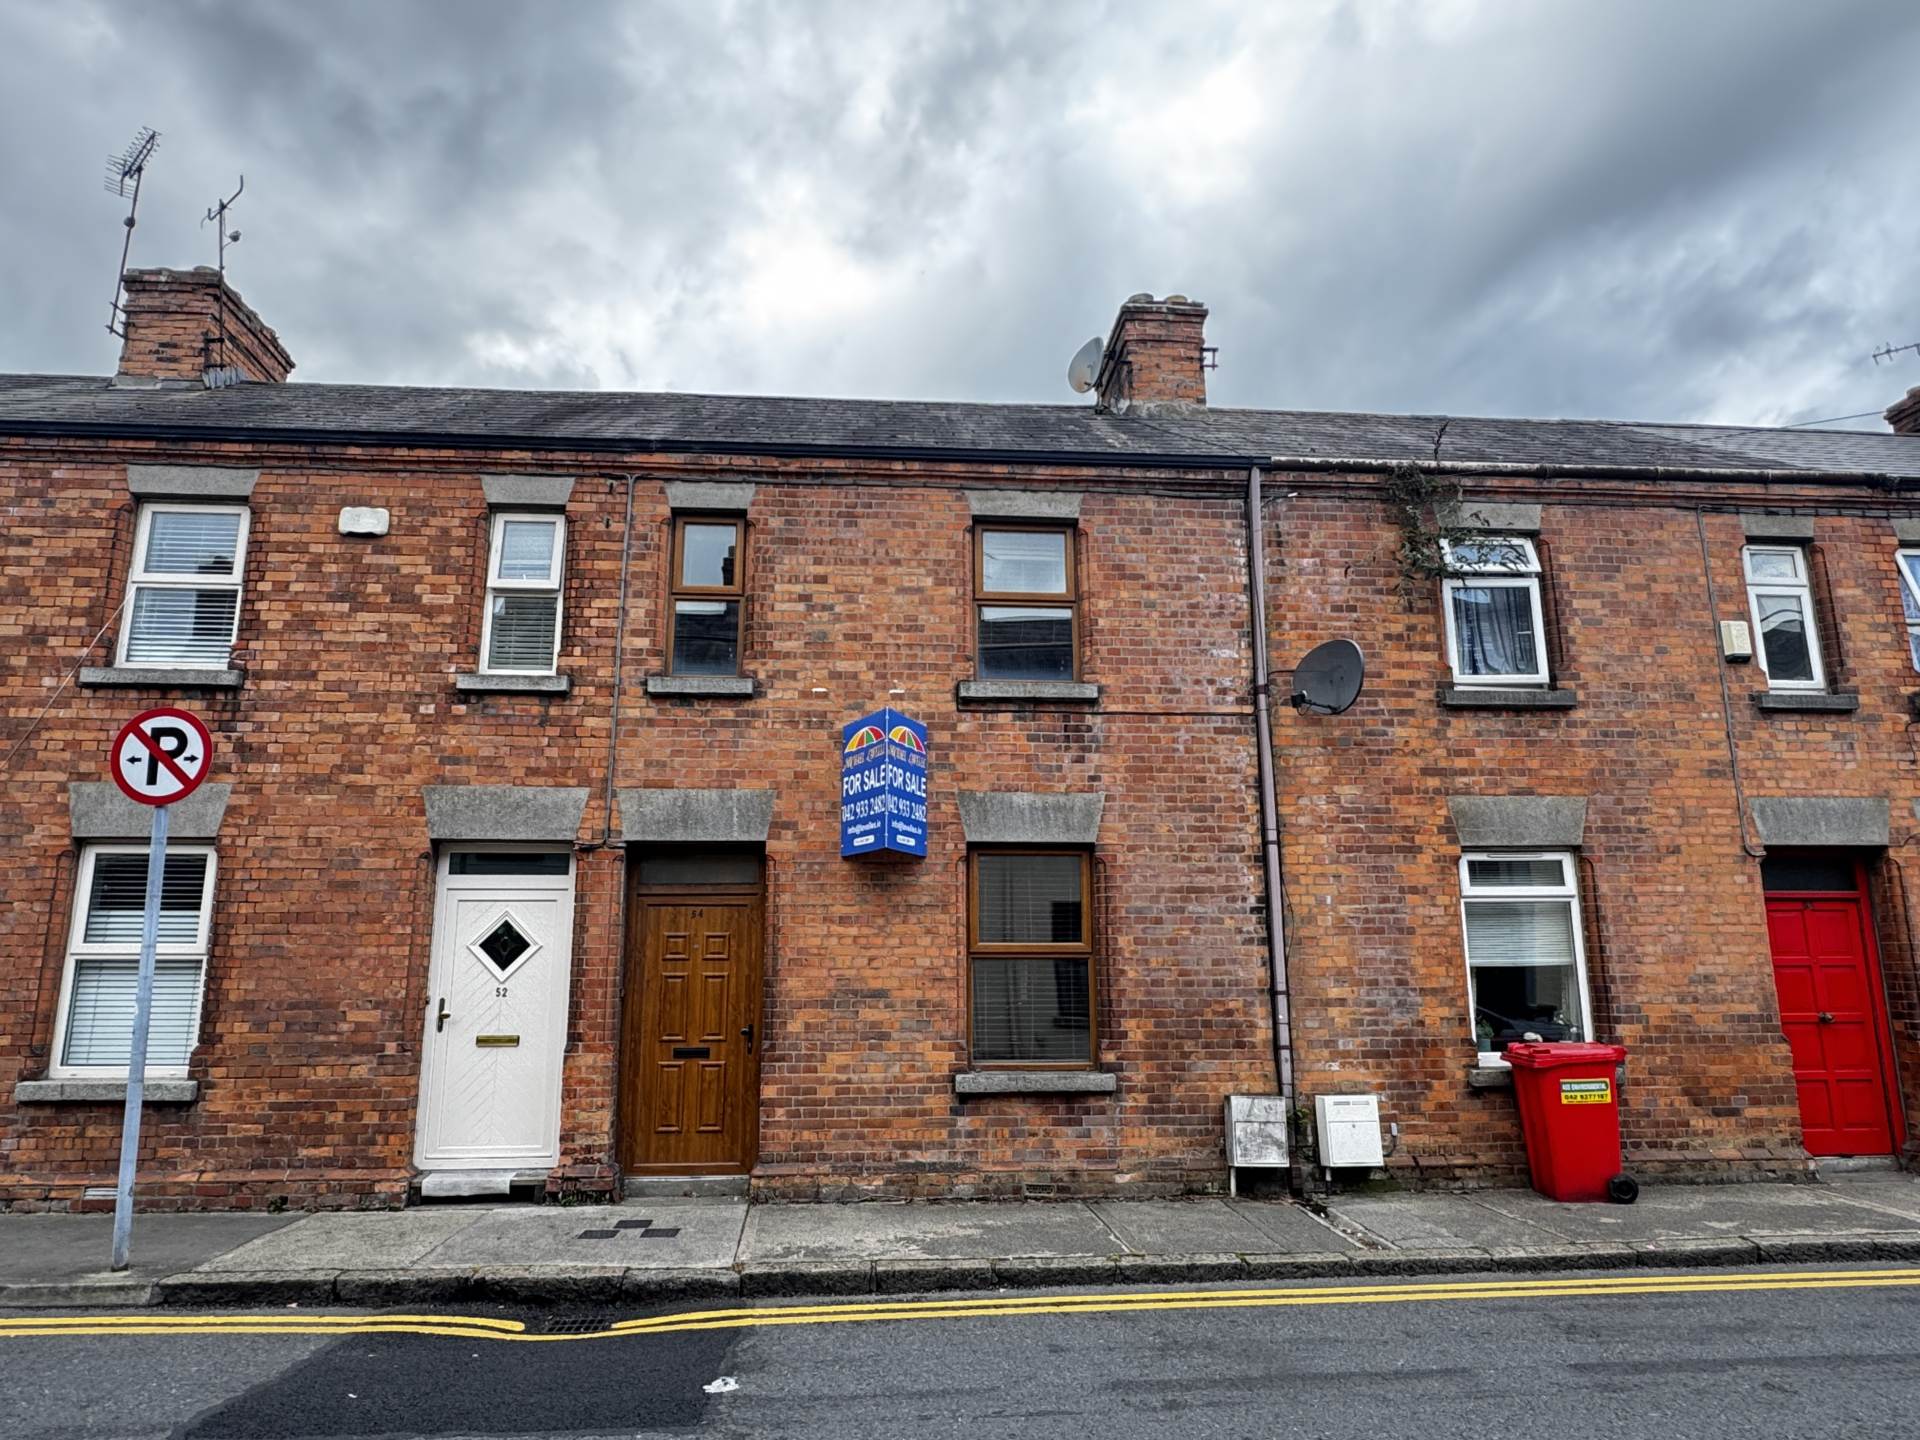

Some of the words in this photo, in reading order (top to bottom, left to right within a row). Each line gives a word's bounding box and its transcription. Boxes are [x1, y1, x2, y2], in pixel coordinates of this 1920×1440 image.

[146, 727, 188, 786] P
[843, 773, 862, 798] FOR
[863, 764, 886, 791] SALE
[887, 764, 904, 790] FOR
[905, 771, 927, 798] SALE
[842, 803, 855, 823] 042
[856, 800, 869, 819] 933
[899, 798, 910, 818] 933
[495, 987, 508, 998] 52
